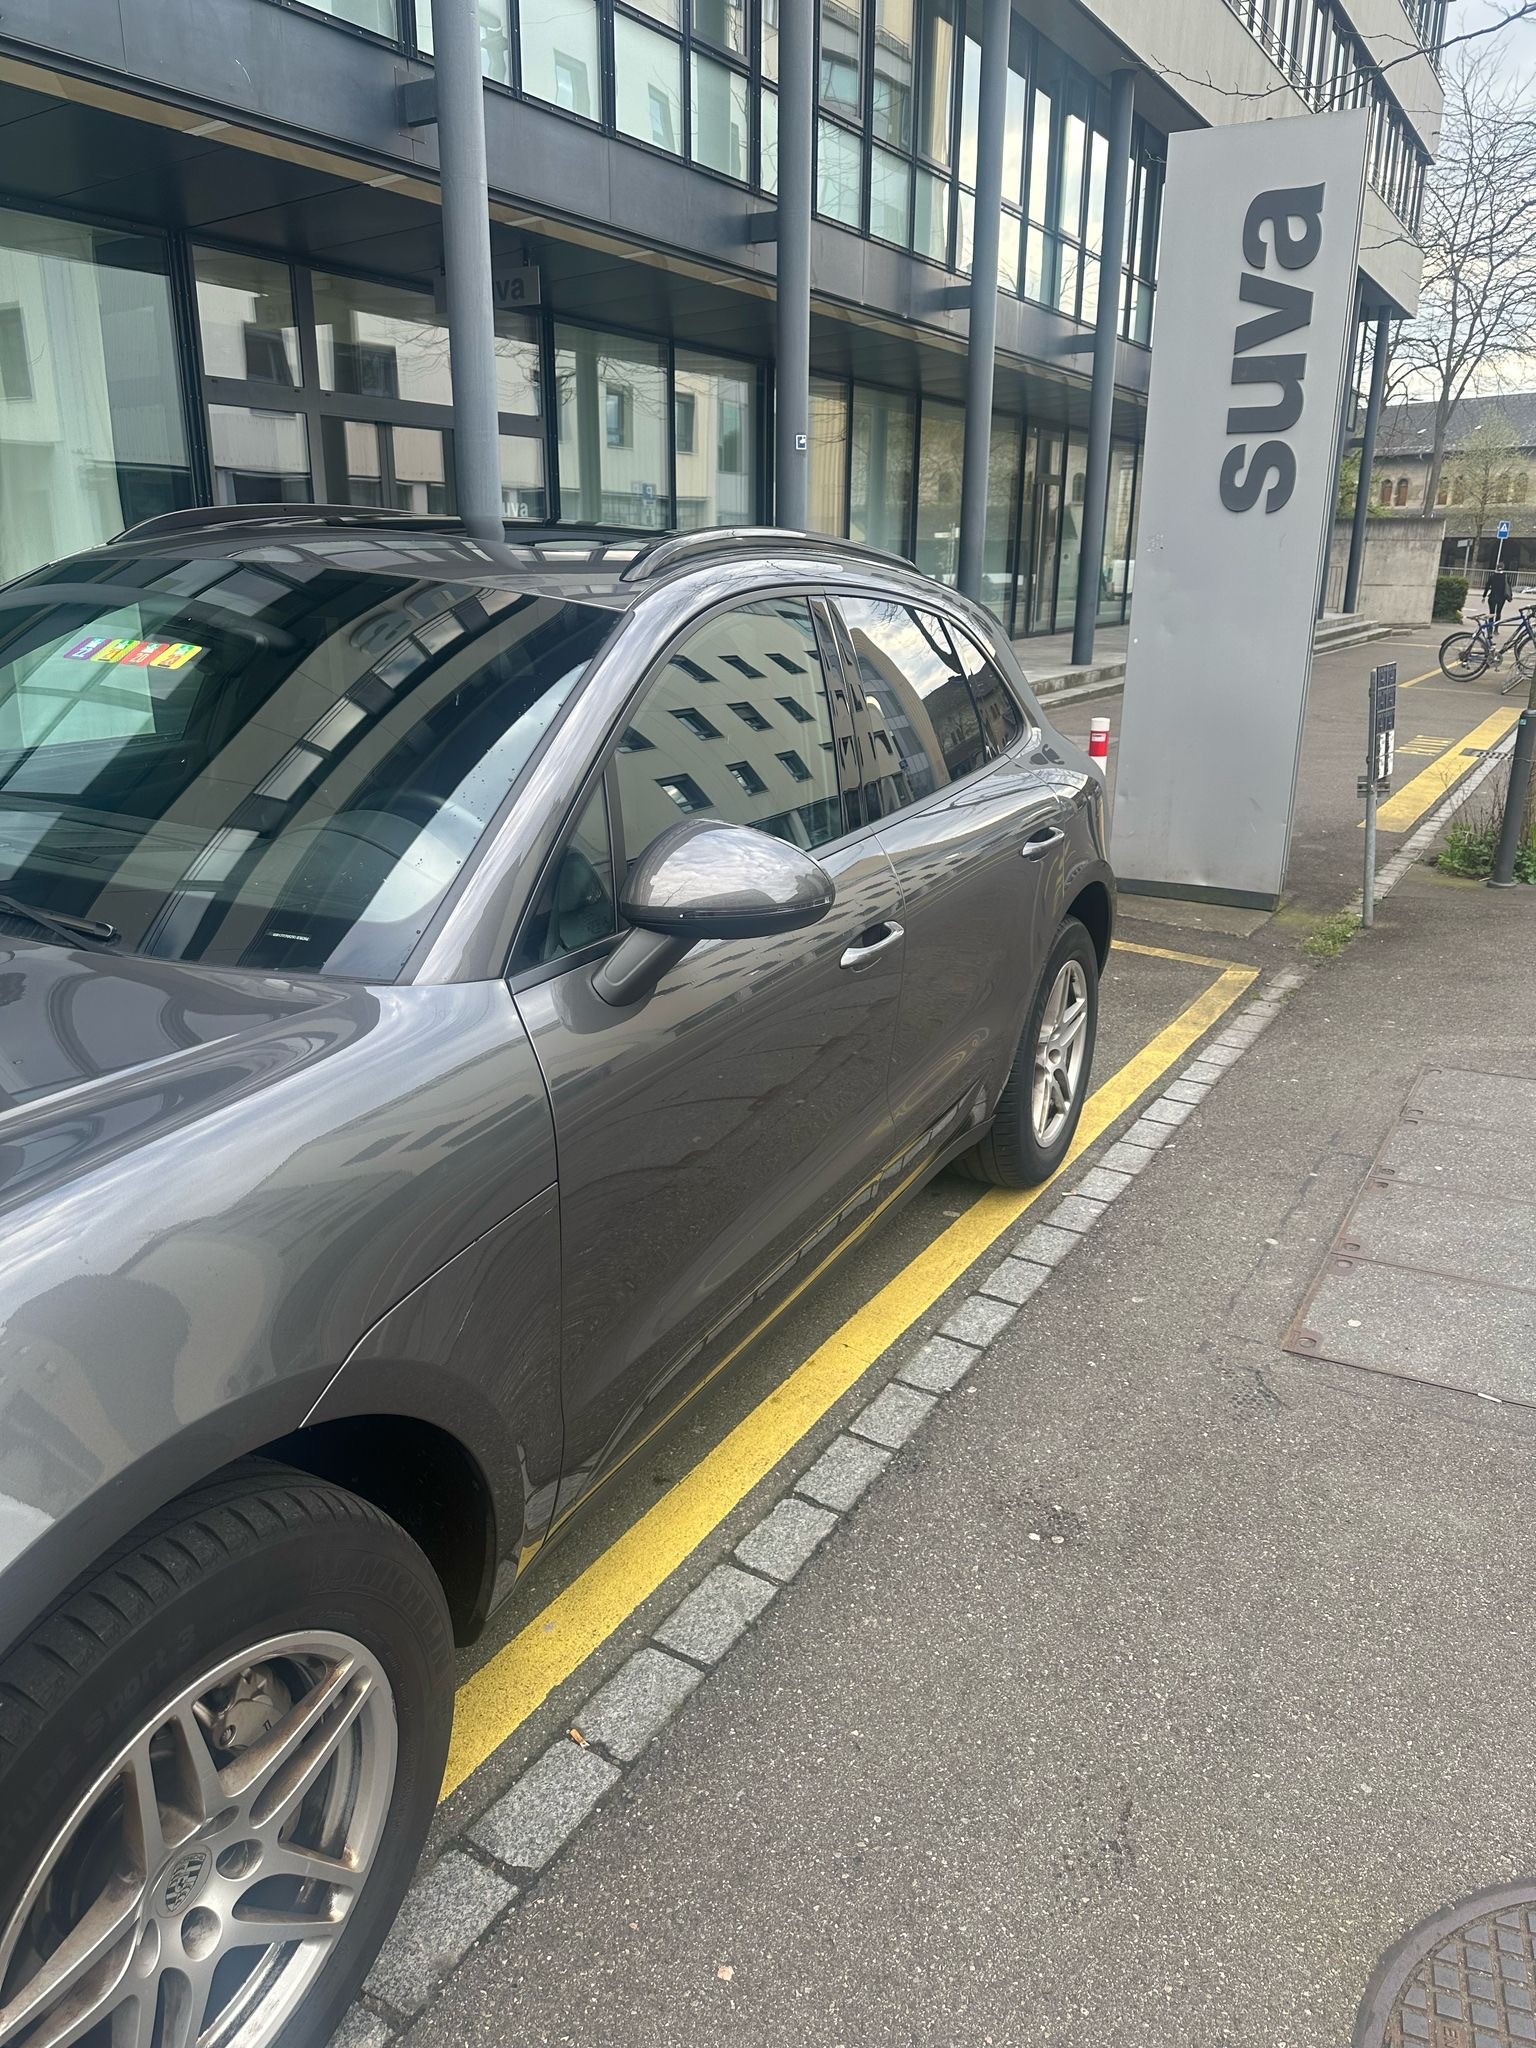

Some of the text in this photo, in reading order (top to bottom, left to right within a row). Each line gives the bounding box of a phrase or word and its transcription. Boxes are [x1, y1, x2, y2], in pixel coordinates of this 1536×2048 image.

[495, 278, 526, 301] va
[1219, 182, 1326, 514] suva
[502, 502, 529, 518] uva
